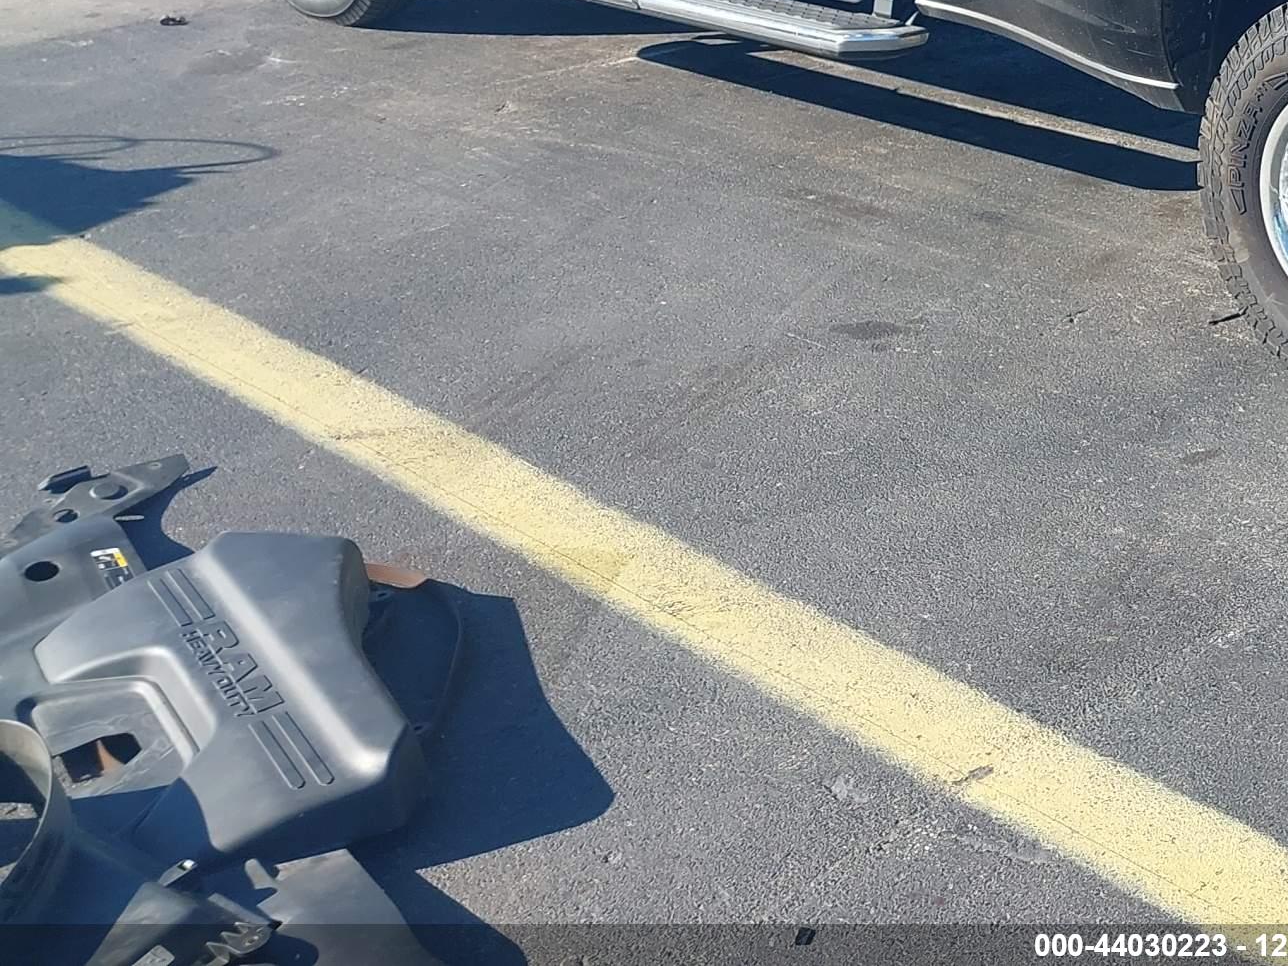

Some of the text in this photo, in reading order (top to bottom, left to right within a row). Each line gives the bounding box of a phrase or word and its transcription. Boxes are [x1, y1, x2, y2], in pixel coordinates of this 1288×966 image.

[1226, 100, 1262, 186] PINZA
[181, 629, 258, 717] HEAVY DUTY
[196, 620, 285, 714] RAM
